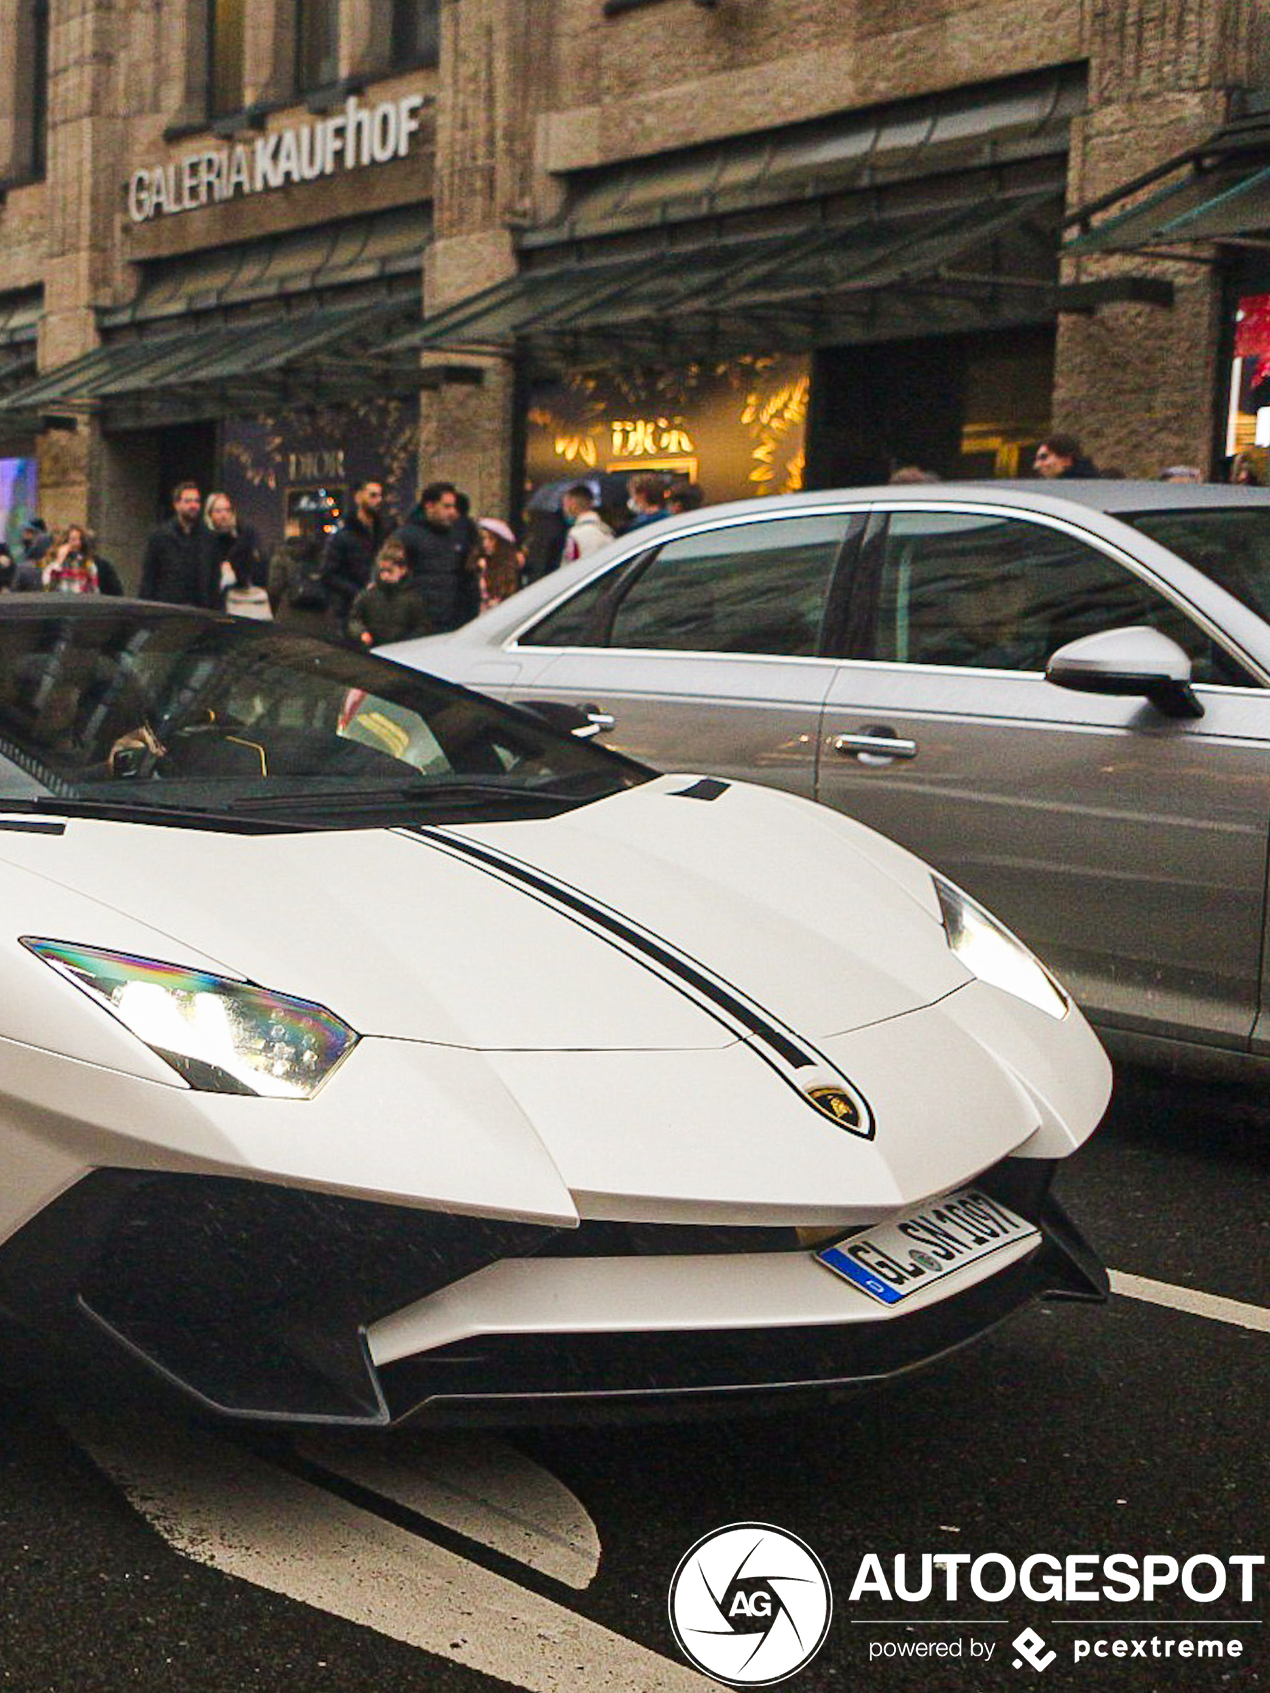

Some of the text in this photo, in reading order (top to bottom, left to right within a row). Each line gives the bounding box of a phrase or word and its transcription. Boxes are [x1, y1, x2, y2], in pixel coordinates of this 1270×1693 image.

[129, 143, 252, 223] GALERIA
[847, 1193, 1020, 1285] GL SN 1097
